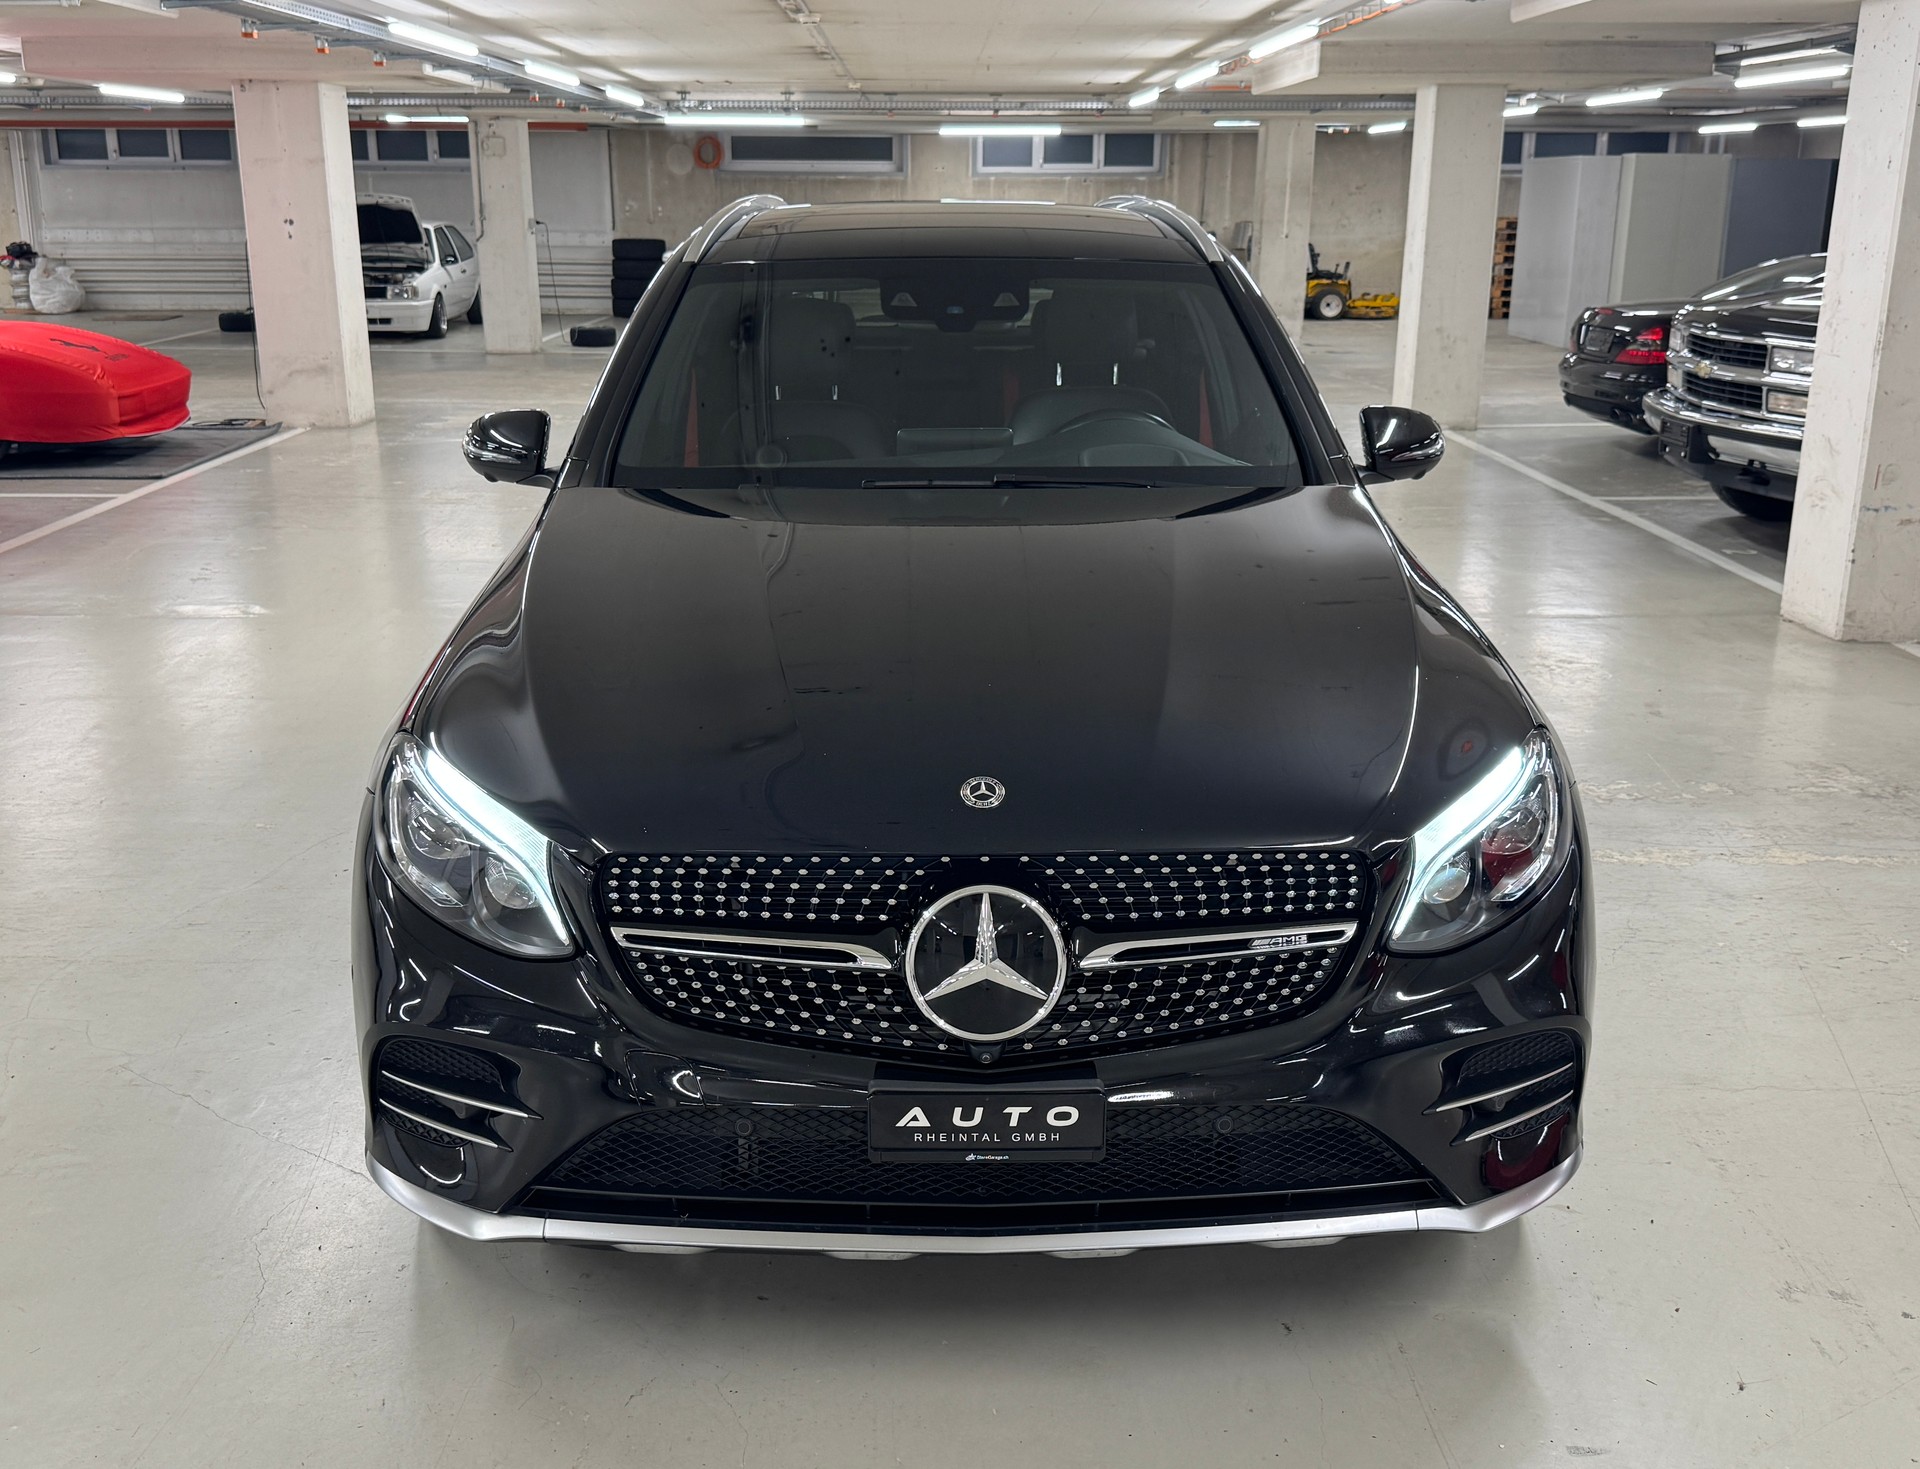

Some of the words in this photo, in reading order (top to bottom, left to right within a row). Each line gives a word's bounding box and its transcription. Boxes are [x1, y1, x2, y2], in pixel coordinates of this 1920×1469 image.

[1269, 934, 1308, 947] AMG
[895, 1106, 1079, 1127] AUTO
[914, 1132, 1001, 1142] RHEINTAL
[1011, 1132, 1060, 1142] GMBH
